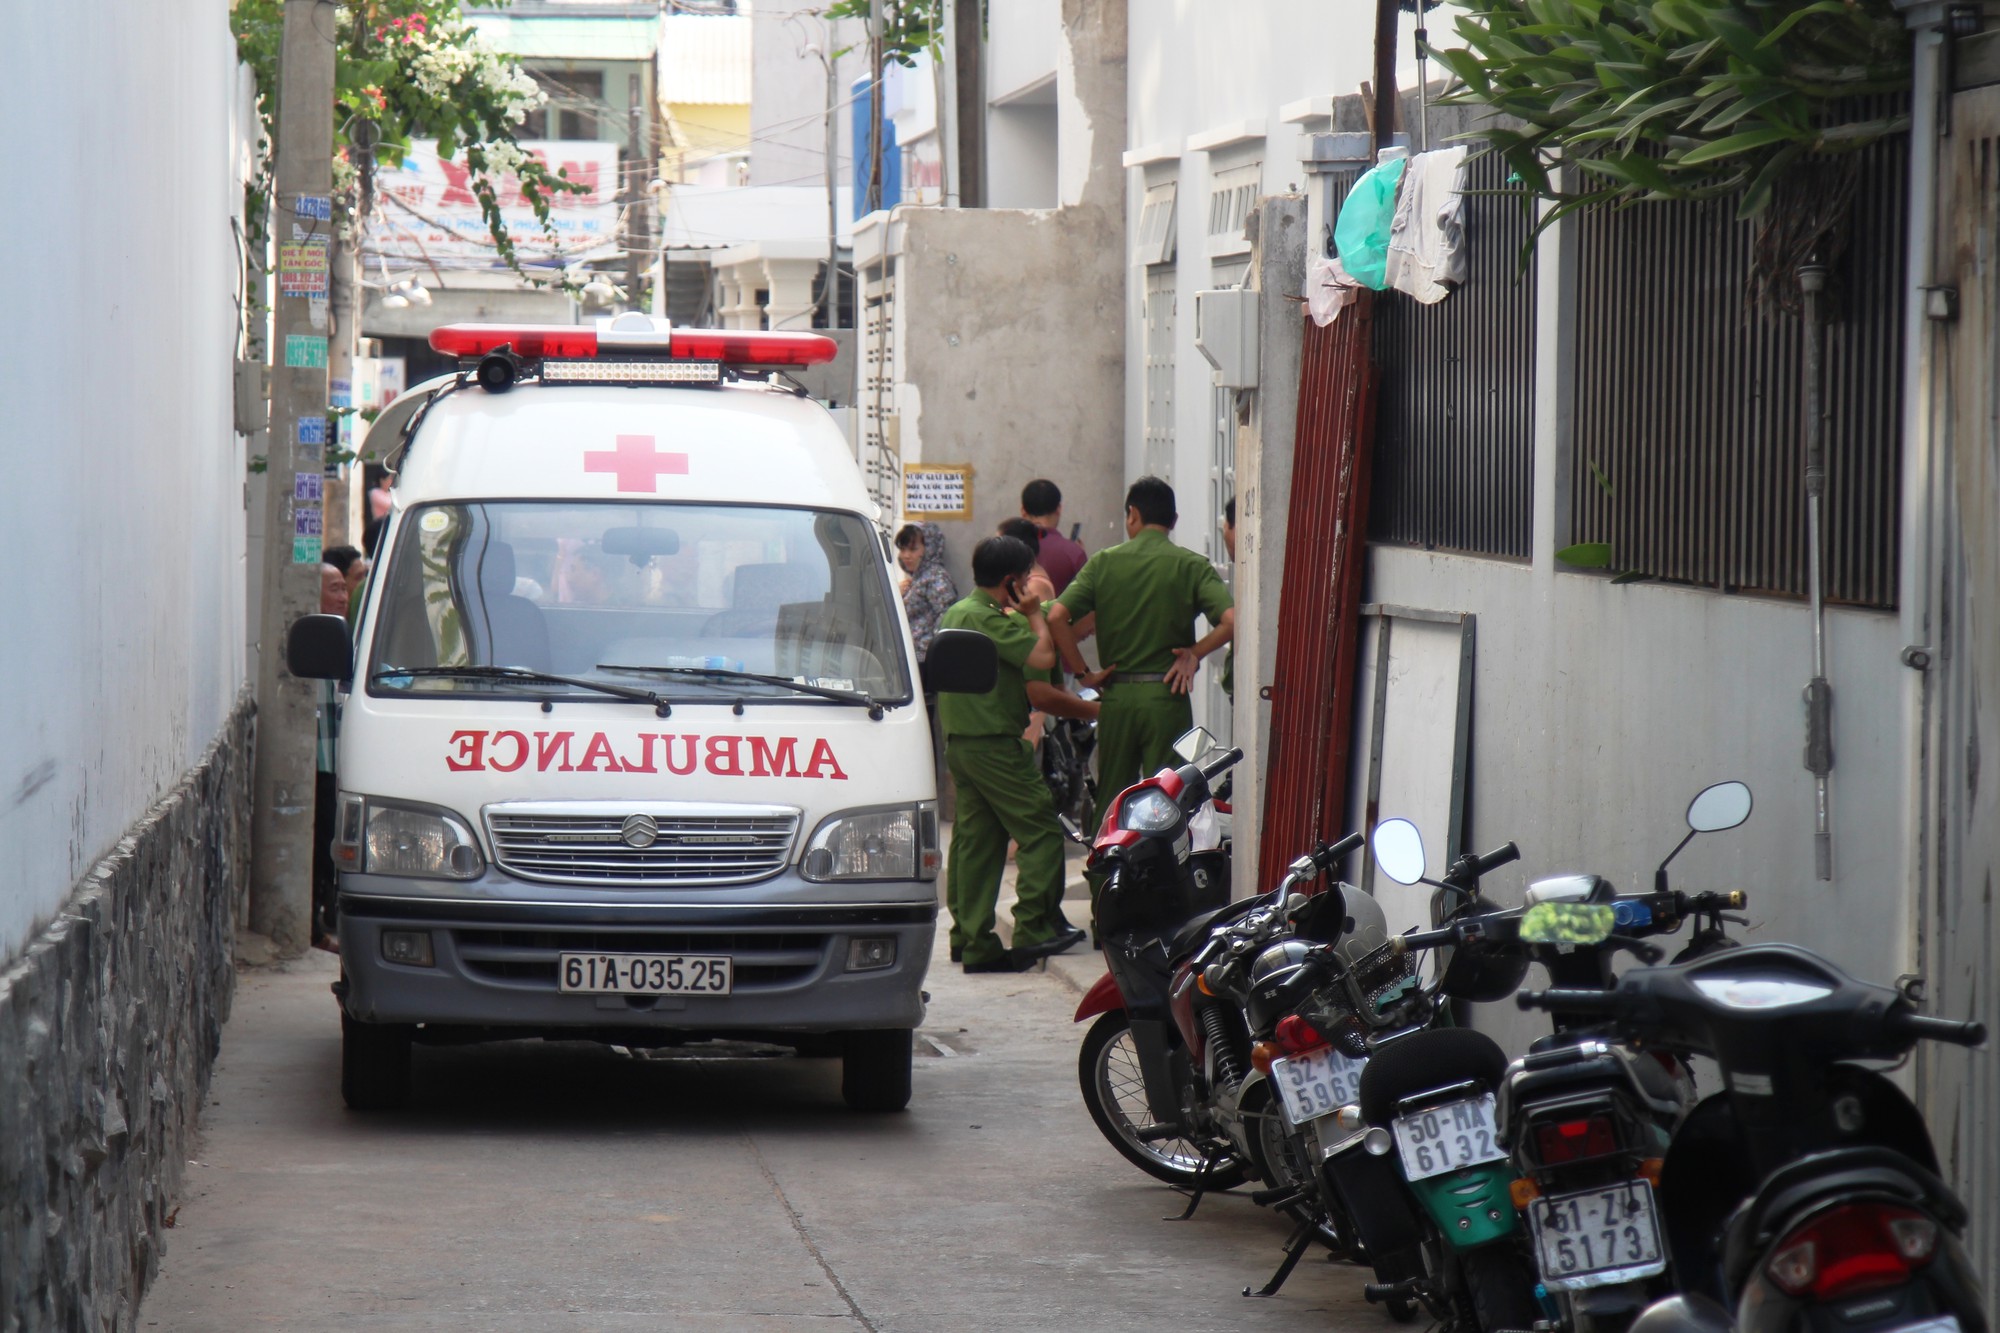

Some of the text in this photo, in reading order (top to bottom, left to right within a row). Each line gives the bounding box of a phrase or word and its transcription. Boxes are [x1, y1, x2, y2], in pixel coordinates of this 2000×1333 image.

[565, 957, 727, 991] 61A-035.25
[1296, 1072, 1360, 1115] 5969
[1408, 1101, 1487, 1144] 50-MA
[1416, 1130, 1494, 1172] 6132
[1557, 1225, 1642, 1271] 5173
